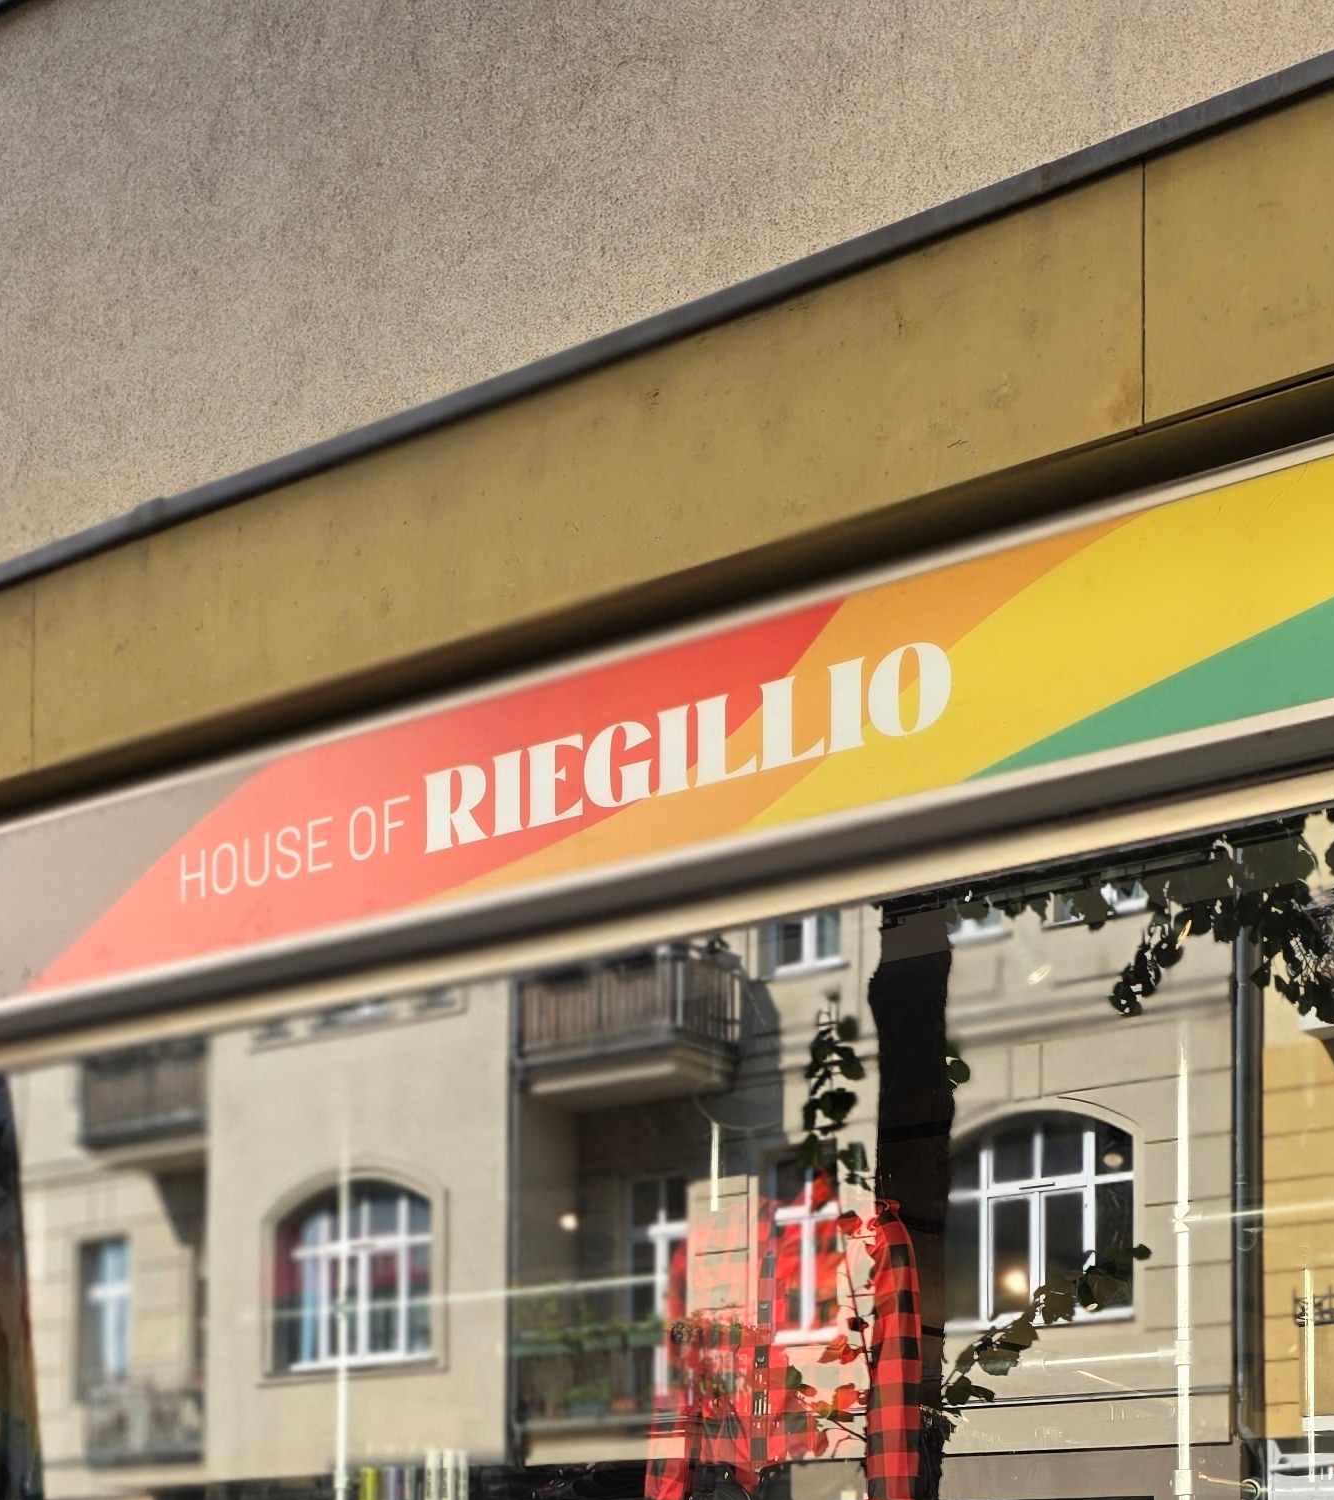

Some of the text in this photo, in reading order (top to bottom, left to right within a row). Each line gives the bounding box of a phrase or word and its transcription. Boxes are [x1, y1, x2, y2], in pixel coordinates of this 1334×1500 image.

[180, 641, 953, 905] HOUSE OF RIEGILLIO
